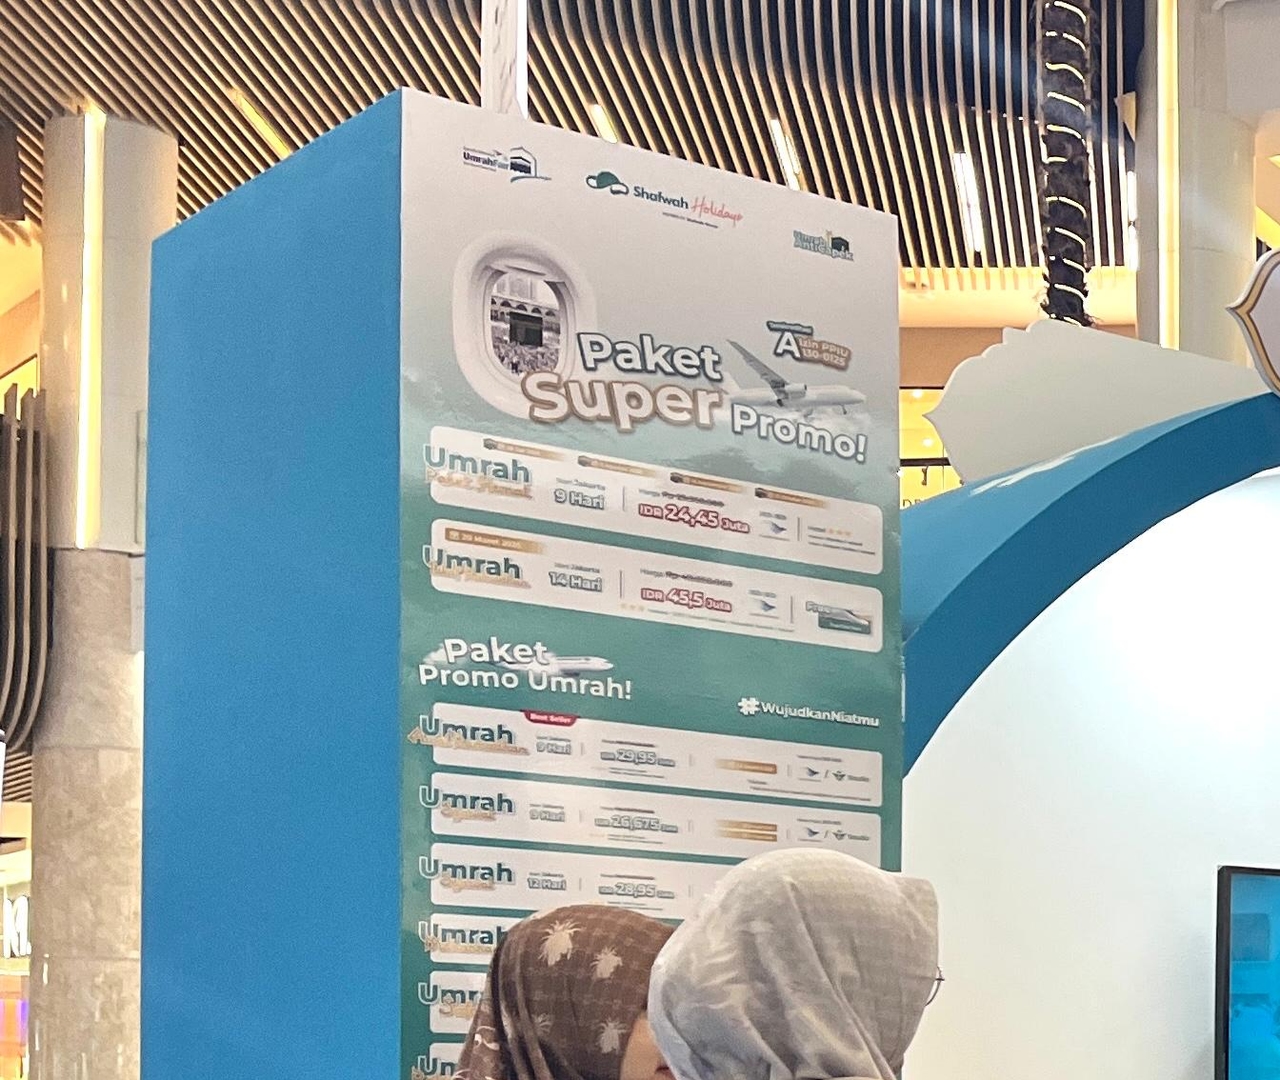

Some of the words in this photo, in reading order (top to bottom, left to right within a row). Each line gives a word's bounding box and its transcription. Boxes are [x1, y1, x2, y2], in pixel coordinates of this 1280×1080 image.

[633, 186, 689, 210] Shafwah
[579, 333, 723, 381] Paket
[775, 331, 801, 358] A
[523, 372, 722, 432] Super
[732, 403, 867, 462] Promo!
[424, 445, 531, 484] Umrah
[554, 488, 567, 504] 9
[569, 491, 605, 510] Hari
[639, 503, 663, 520] IDR
[665, 503, 719, 528] 24,45
[721, 517, 750, 533] Juta
[423, 544, 525, 581] Umrah
[549, 571, 569, 587] 14
[569, 574, 603, 593] Hari
[641, 588, 665, 602] IDR
[705, 597, 733, 613] Juta
[444, 636, 550, 665] Paket
[418, 664, 519, 689] Promo
[528, 670, 633, 700] Umrah!
[738, 697, 880, 728] #WujudkanNiatmu
[419, 714, 514, 746] Umrah
[419, 785, 515, 815] Umrah
[419, 856, 515, 884] Umrah
